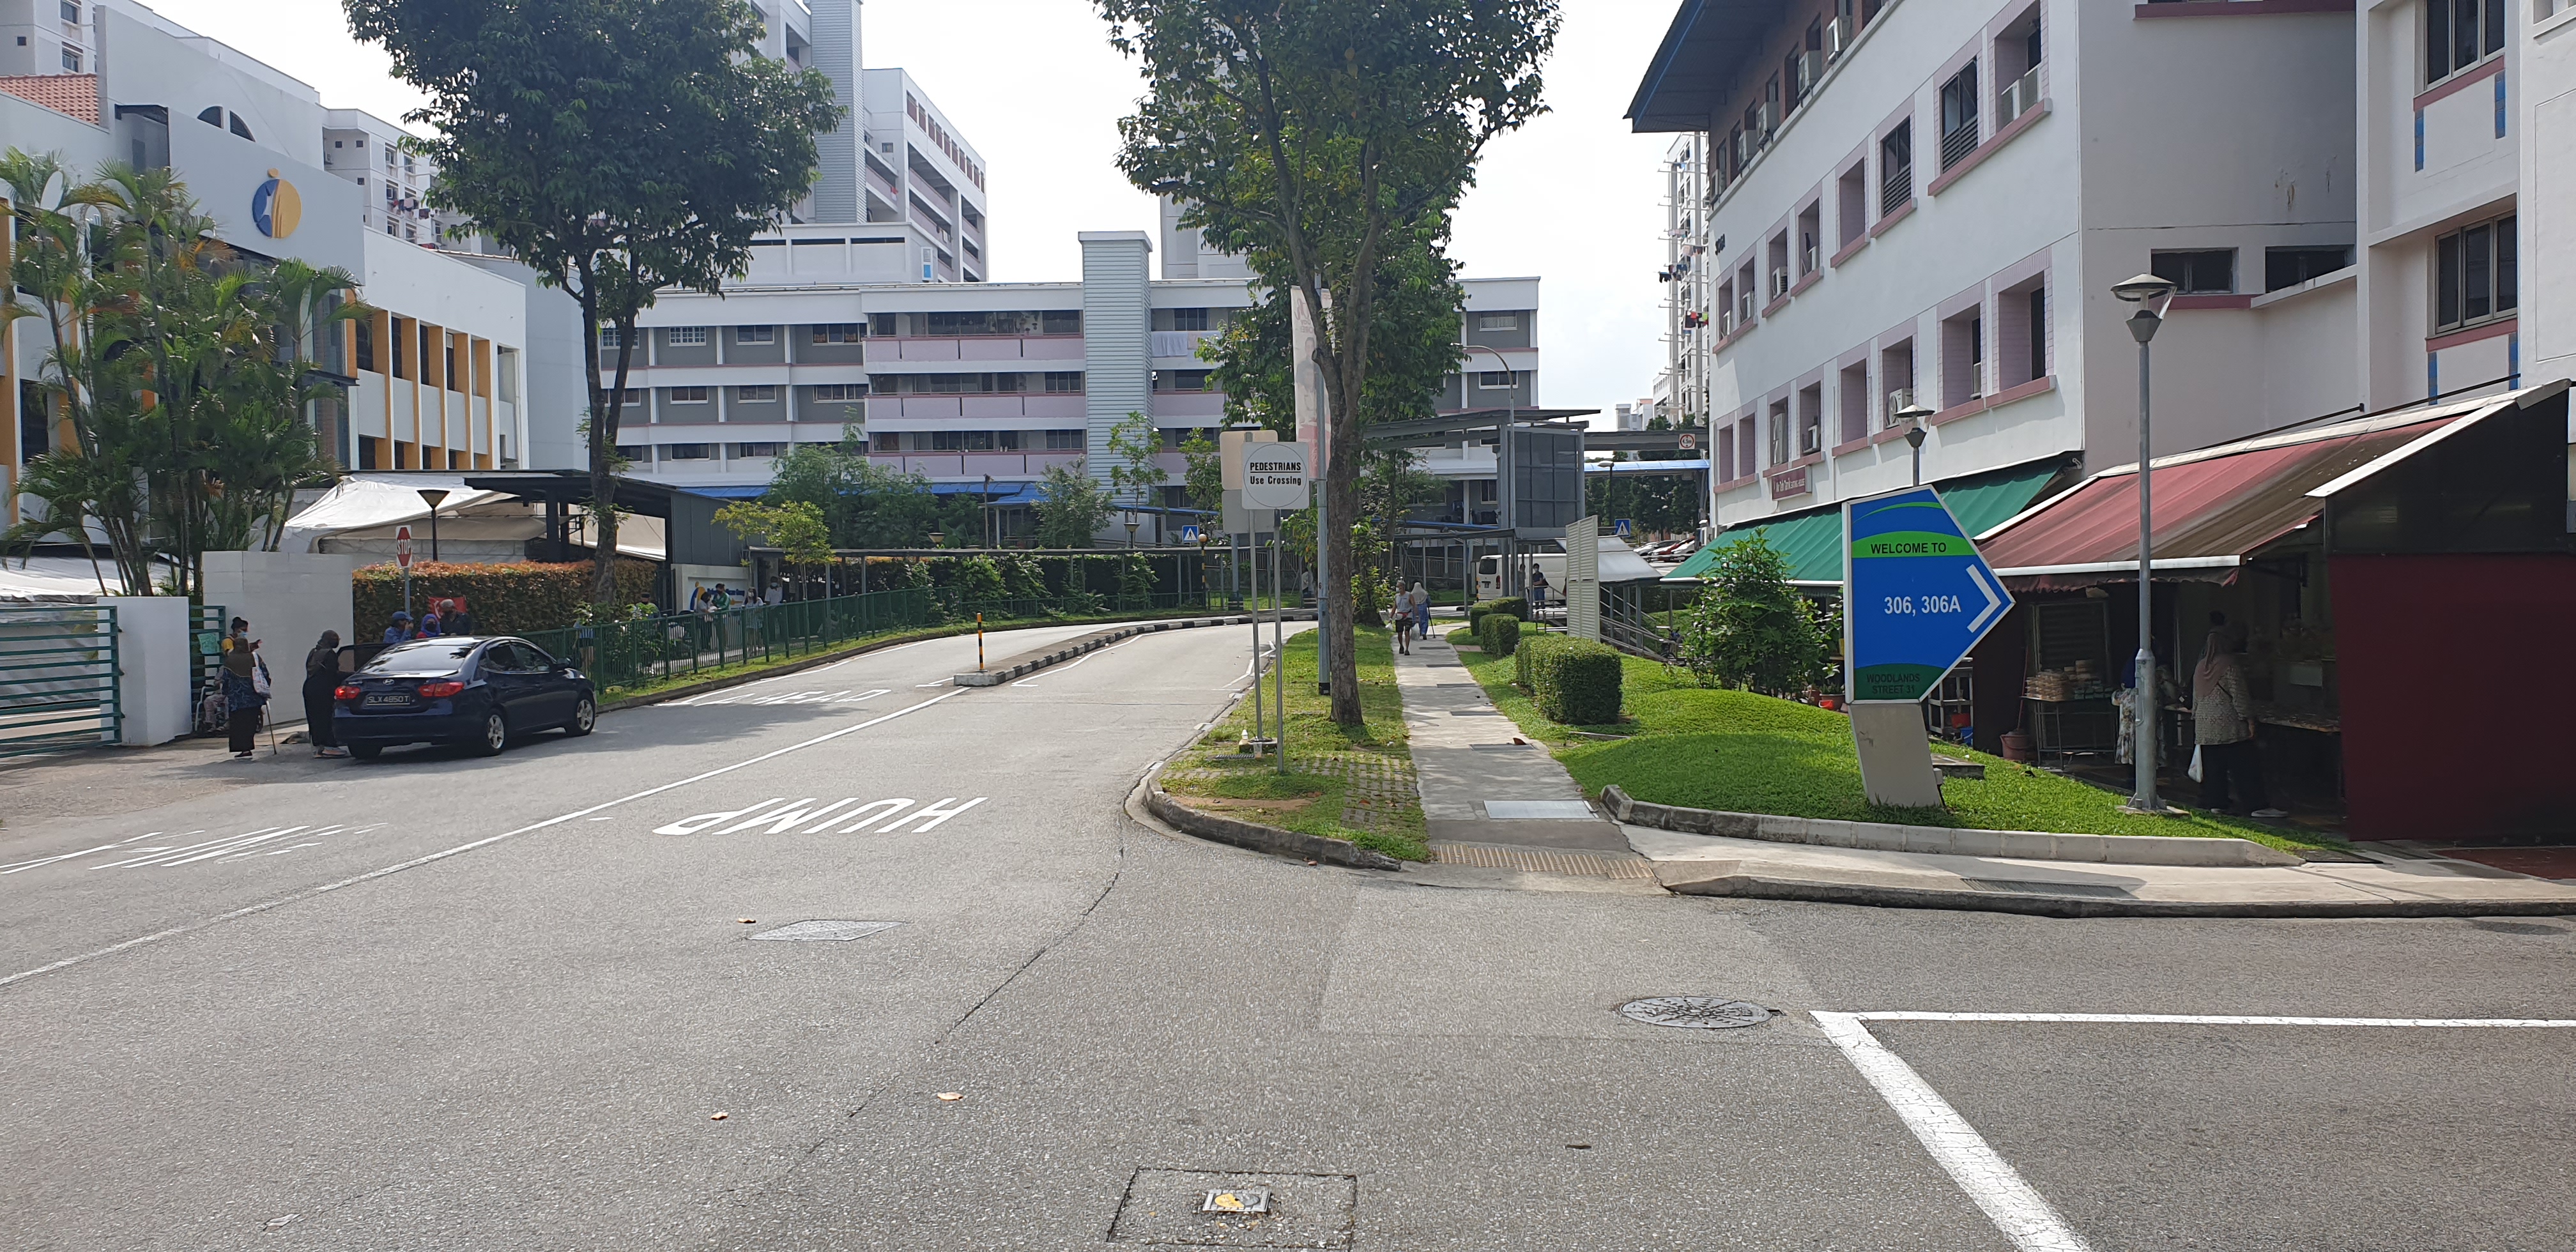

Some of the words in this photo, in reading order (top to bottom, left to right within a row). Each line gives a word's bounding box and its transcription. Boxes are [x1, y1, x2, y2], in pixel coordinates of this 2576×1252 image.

[1250, 462, 1301, 471] PEDESTRIANS
[1250, 476, 1264, 485] Use
[1268, 475, 1301, 486] Crossing
[397, 538, 411, 555] STOP
[1870, 543, 1928, 554] WELCOME
[1931, 542, 1947, 553] TO
[1884, 596, 1916, 616] 306,
[1921, 595, 1961, 613] 306A
[1866, 673, 1920, 683] WOODLANDS
[1872, 685, 1904, 694] STREET
[1906, 685, 1915, 694] 31
[694, 689, 892, 706] AHEAD
[652, 797, 989, 836] HUMP
